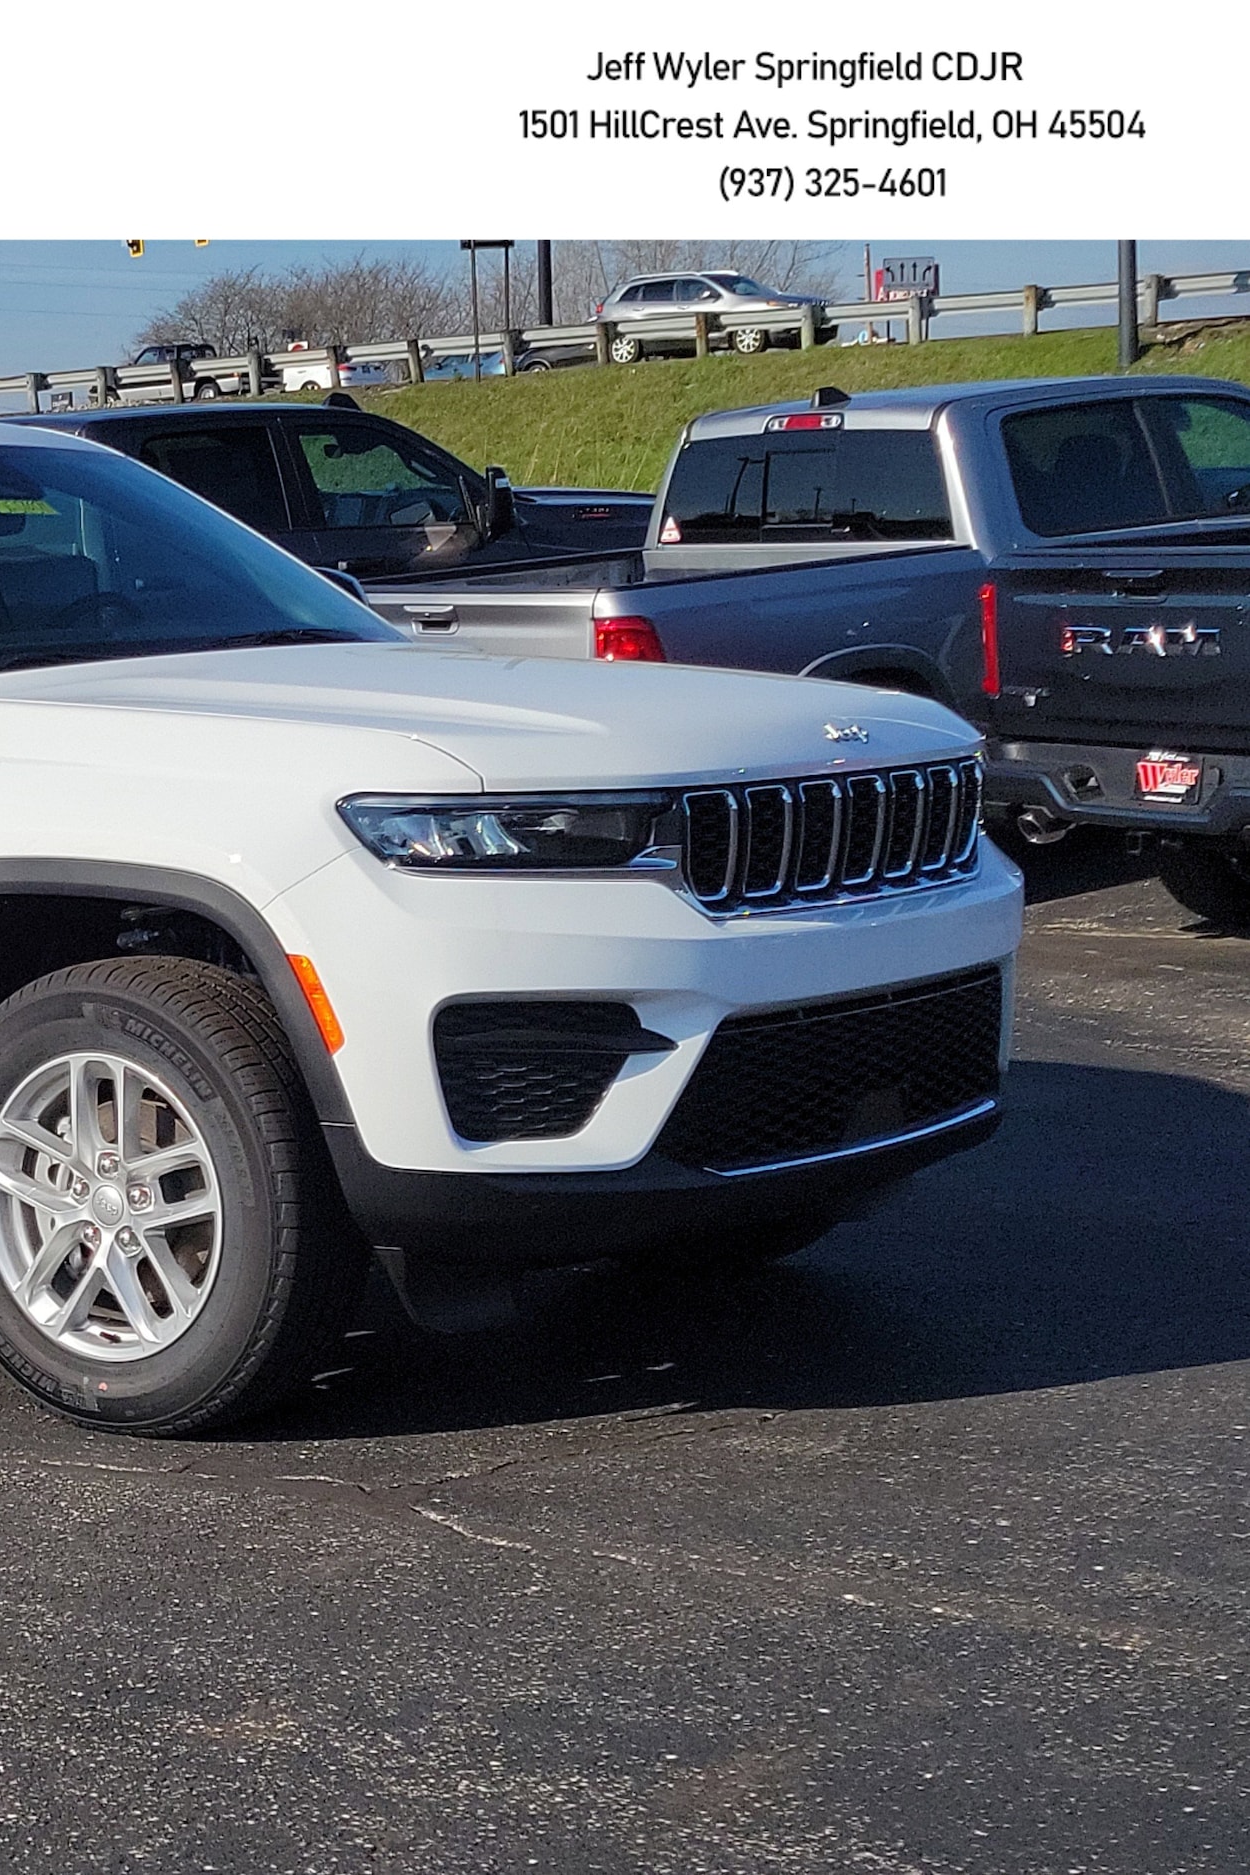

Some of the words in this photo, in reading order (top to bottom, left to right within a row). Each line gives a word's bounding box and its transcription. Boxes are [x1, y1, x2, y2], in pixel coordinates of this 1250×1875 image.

[1060, 625, 1221, 657] RAM
[1136, 761, 1200, 793] Wyler
[123, 1017, 214, 1102] MICHELIN
